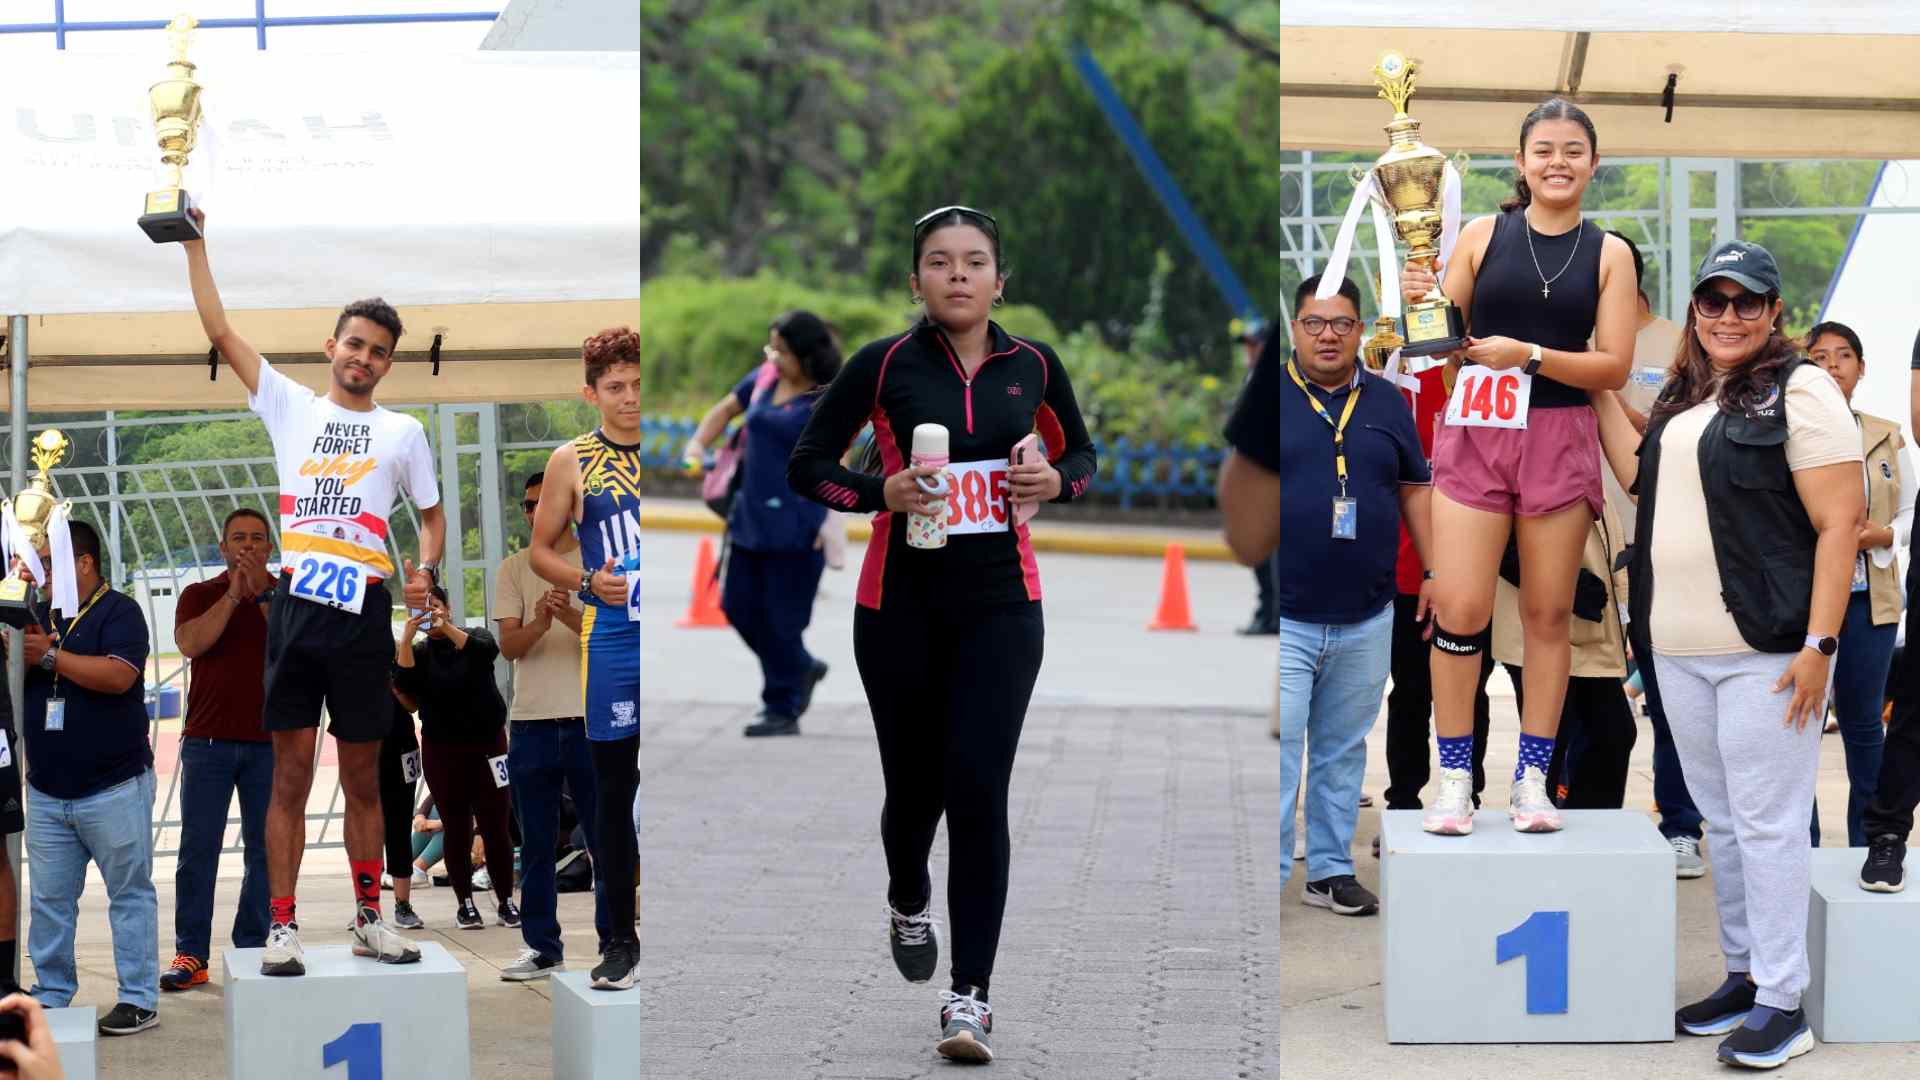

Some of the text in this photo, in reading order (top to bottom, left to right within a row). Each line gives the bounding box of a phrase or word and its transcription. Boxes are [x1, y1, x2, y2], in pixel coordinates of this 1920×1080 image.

[1461, 375, 1520, 420] 146
[313, 437, 372, 454] FORGET
[324, 422, 370, 437] NEVER
[298, 451, 378, 487] why
[314, 478, 346, 496] YOU
[296, 496, 361, 518] STARTED
[946, 470, 1008, 525] 385
[295, 558, 359, 602] 226
[496, 758, 508, 782] 3
[1496, 911, 1568, 1014] 1
[323, 1022, 382, 1080] 1
